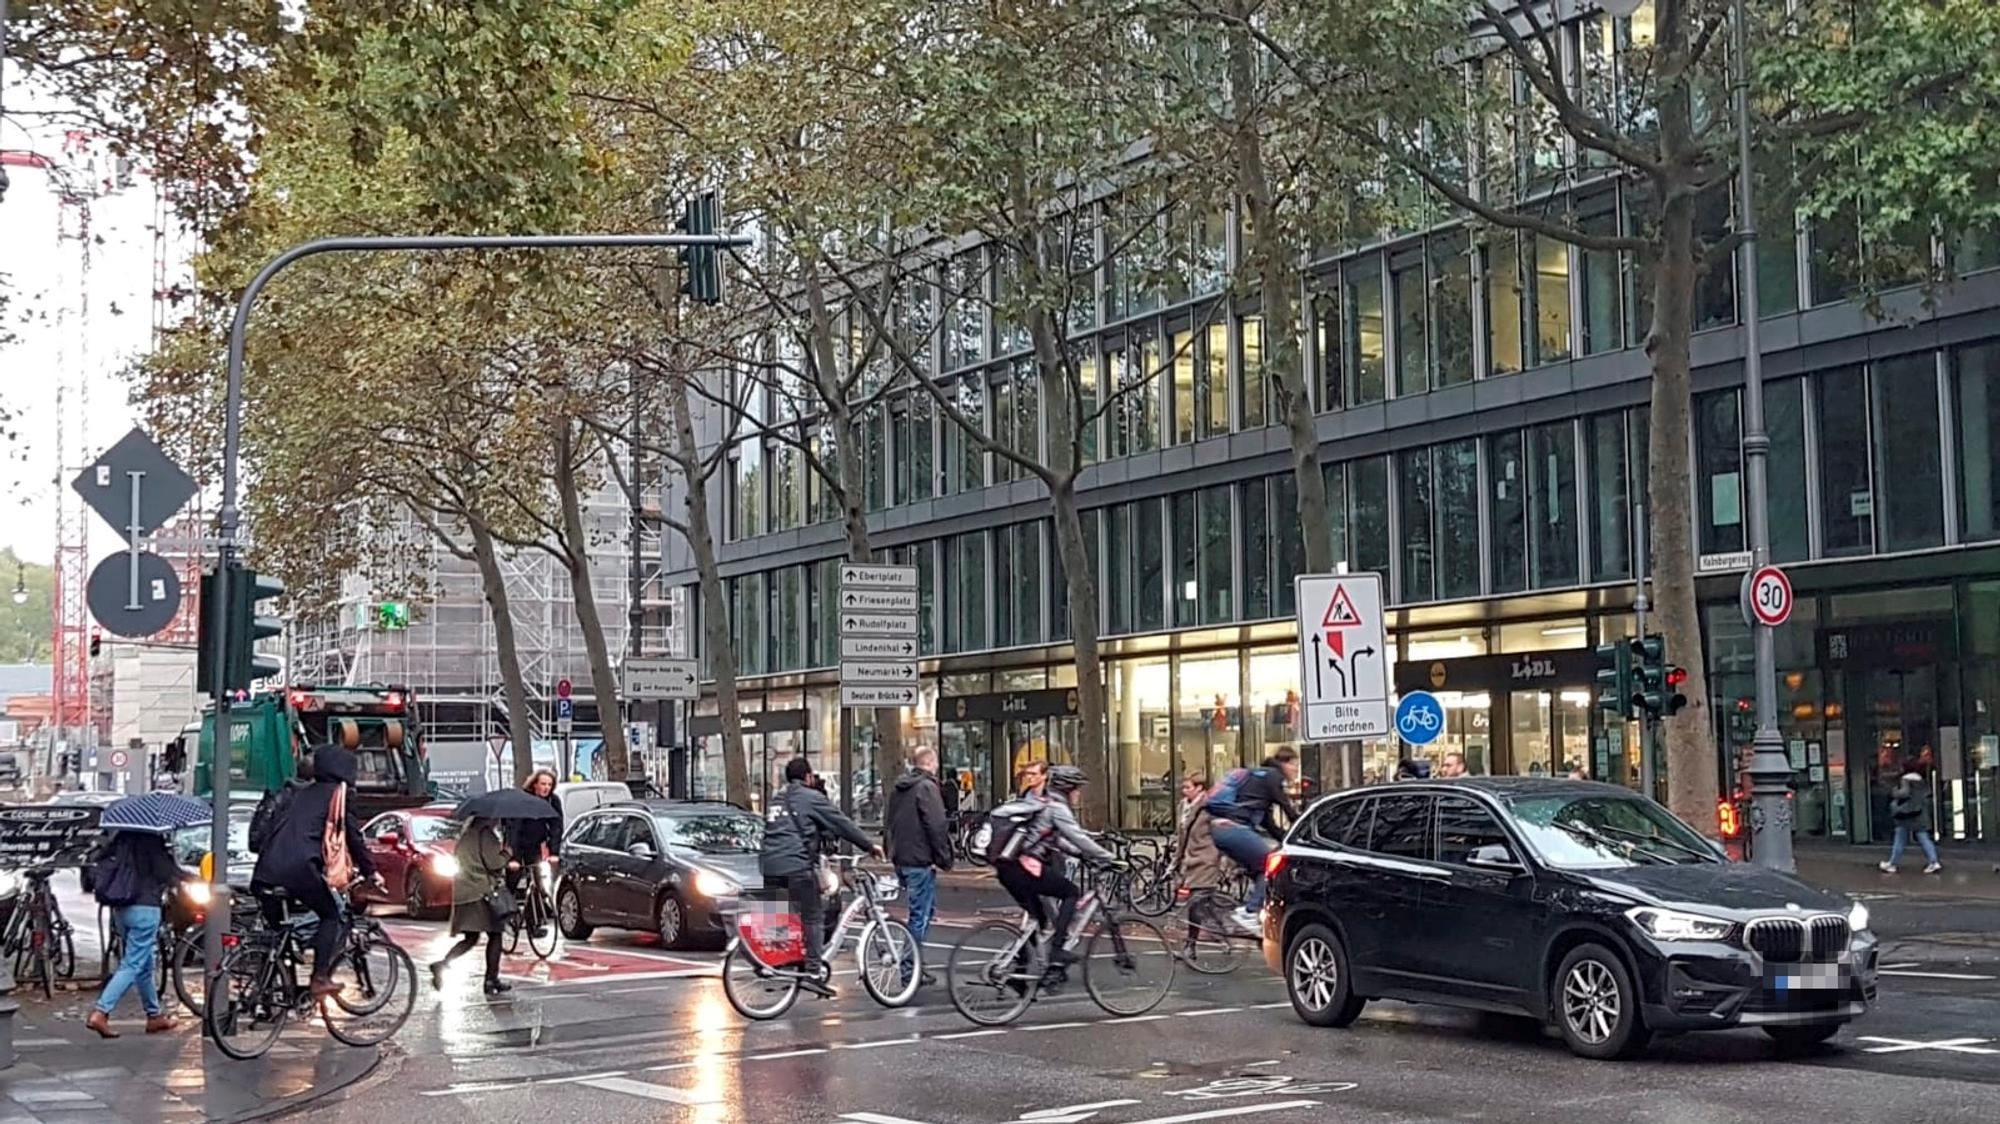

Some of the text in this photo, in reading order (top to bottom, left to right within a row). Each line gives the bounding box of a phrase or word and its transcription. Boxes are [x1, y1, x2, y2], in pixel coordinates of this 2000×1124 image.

[859, 571, 902, 582] Ebertplatz
[859, 595, 911, 607] Friesenplatz
[1760, 582, 1783, 609] 30
[859, 619, 907, 630] Rudolfplatz
[855, 643, 900, 652] Lindenthal
[857, 667, 900, 677] Neumarkt
[1335, 706, 1360, 718] Bitte
[1321, 721, 1375, 734] einordnen
